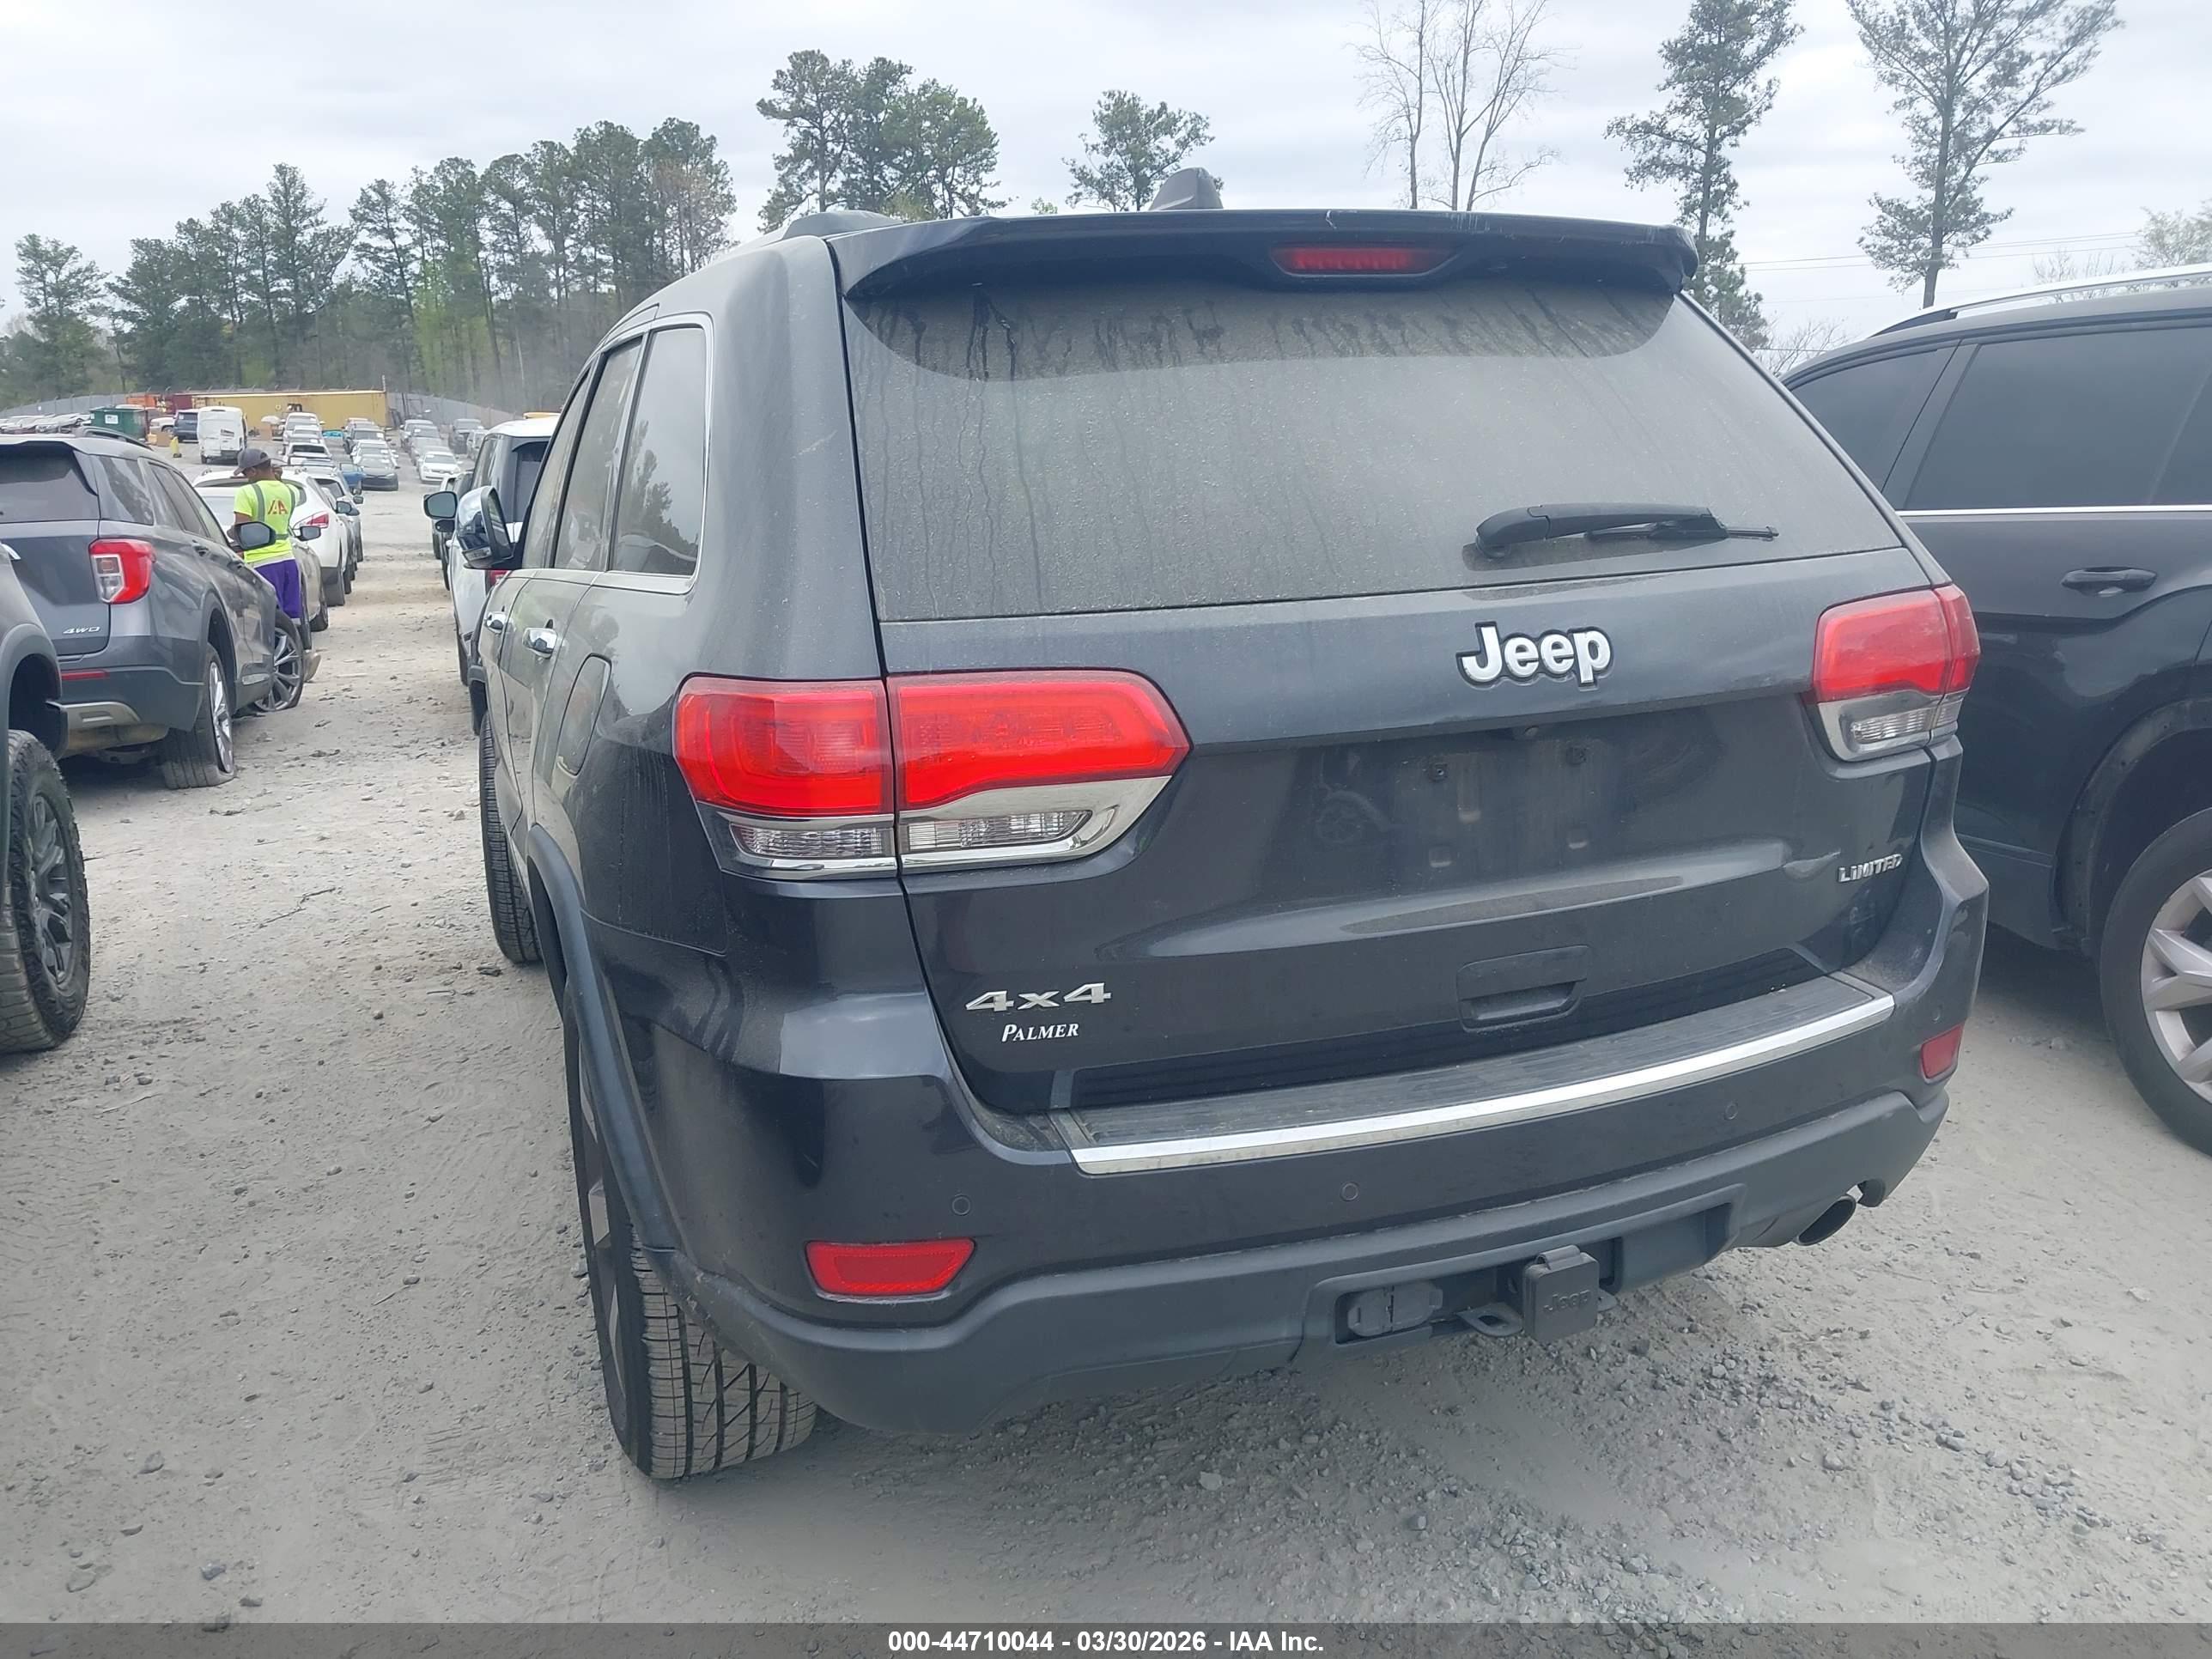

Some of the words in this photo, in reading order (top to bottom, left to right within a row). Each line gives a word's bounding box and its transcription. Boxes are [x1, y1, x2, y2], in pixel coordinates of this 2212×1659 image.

[1457, 622, 1612, 687] Jeep
[1838, 854, 1903, 882] LIMITED
[1001, 1023, 1079, 1042] PALMER
